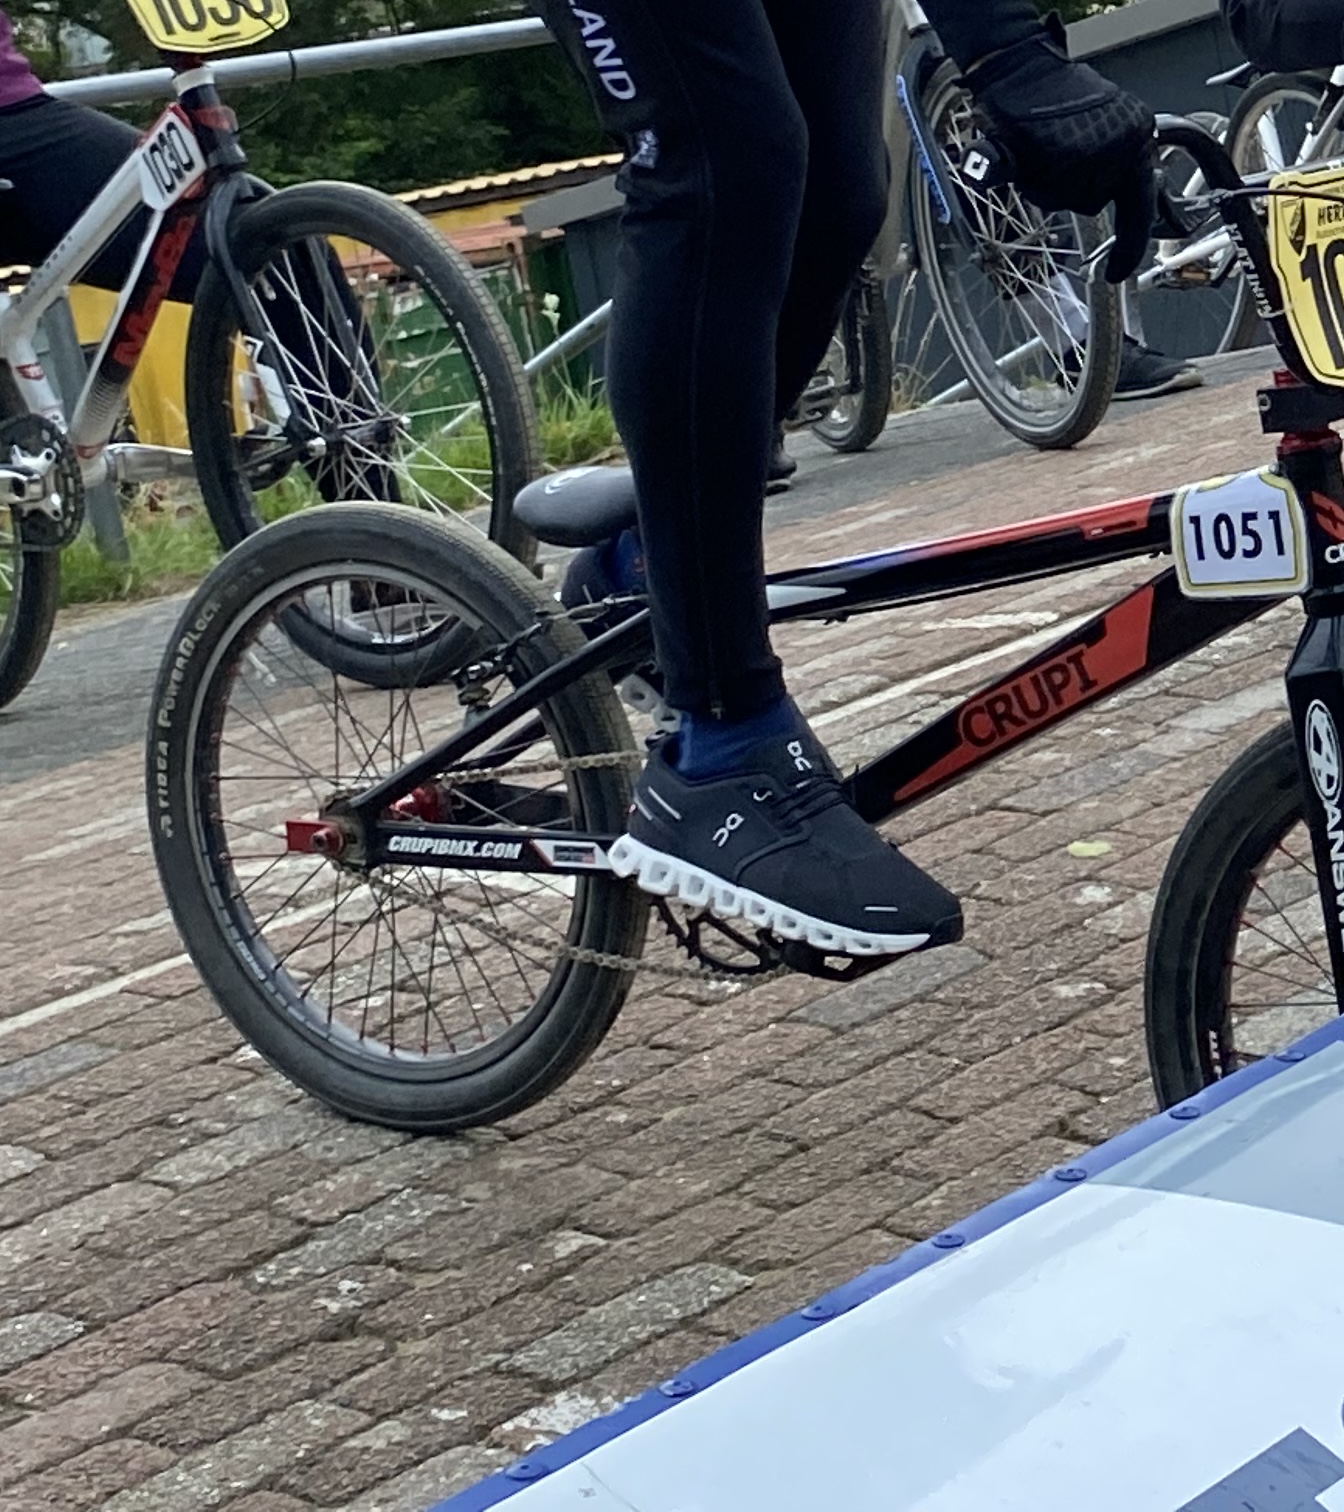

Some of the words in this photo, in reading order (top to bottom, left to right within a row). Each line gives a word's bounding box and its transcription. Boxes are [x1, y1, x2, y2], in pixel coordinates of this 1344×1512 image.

[142, 121, 196, 201] 1030
[1188, 509, 1286, 562] 1051
[961, 648, 1099, 748] CRUPI
[388, 834, 523, 860] CRUPIBMX.COM
